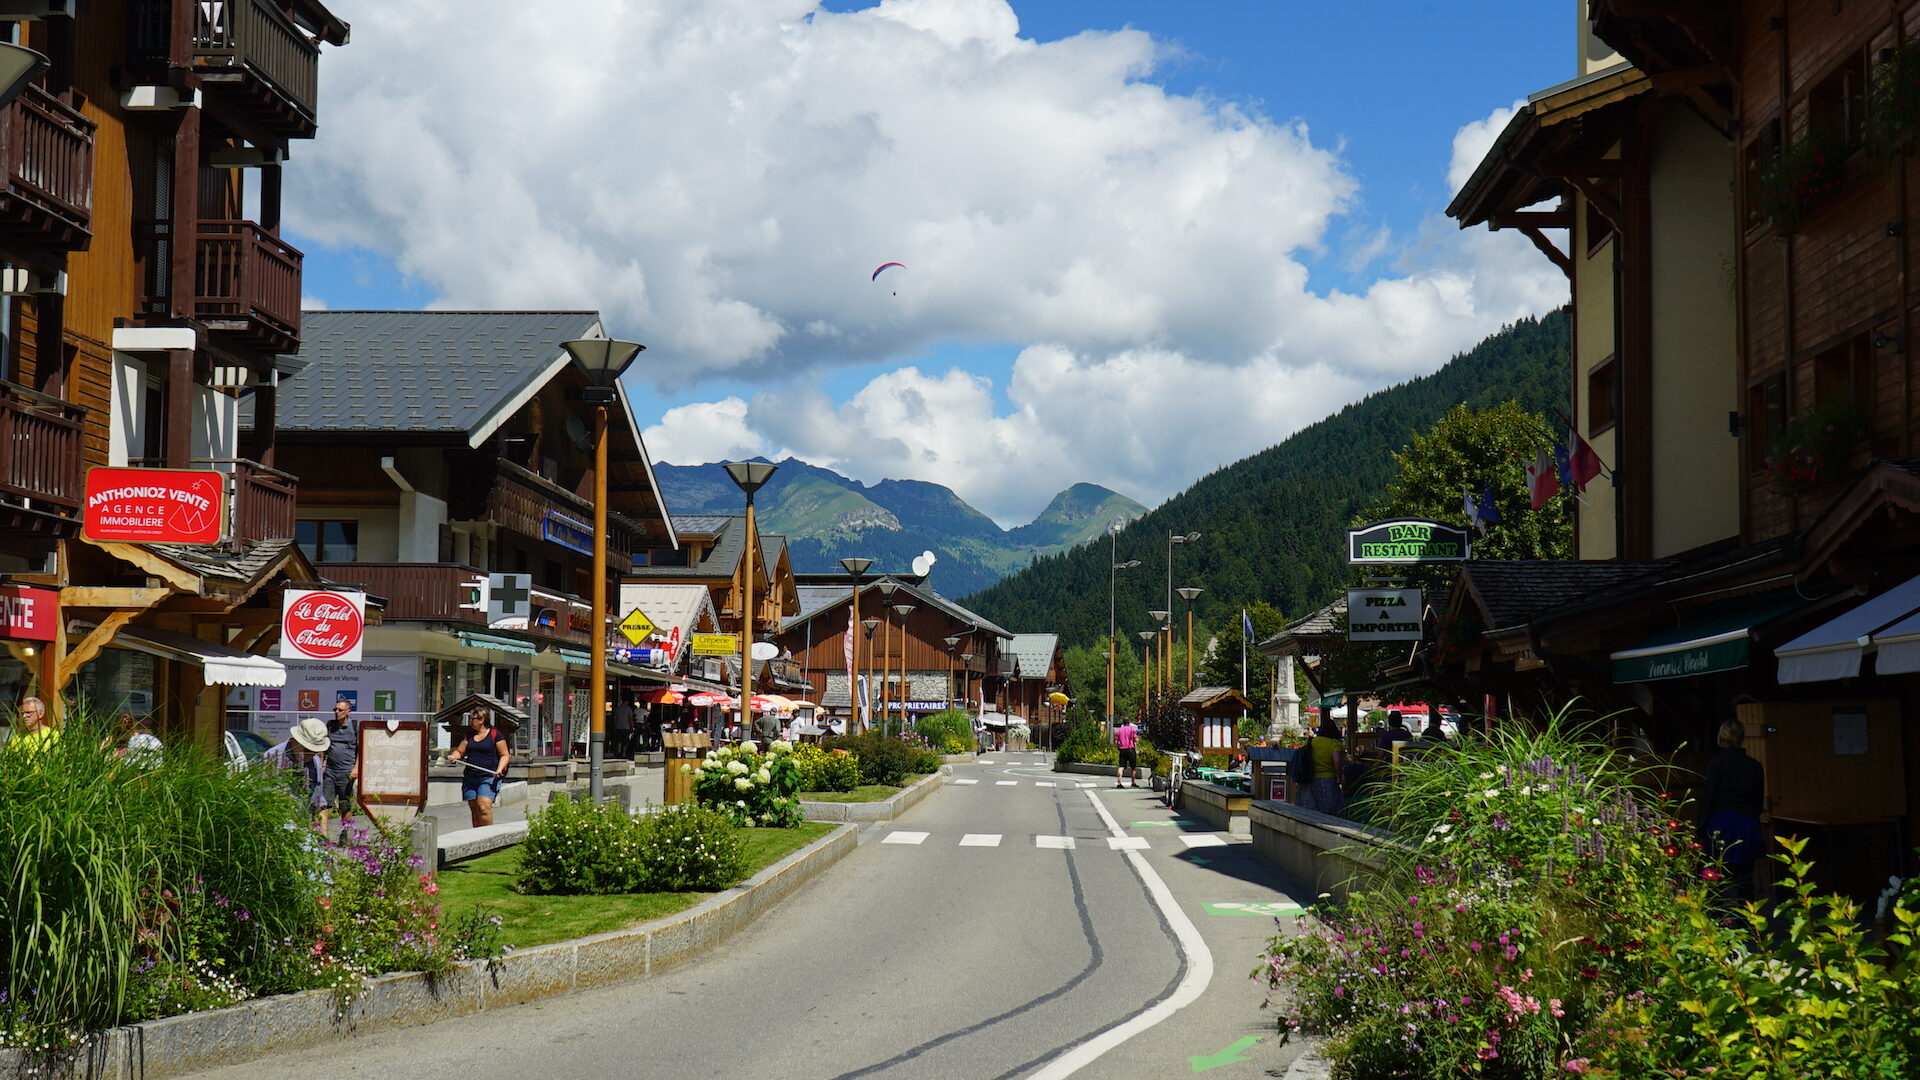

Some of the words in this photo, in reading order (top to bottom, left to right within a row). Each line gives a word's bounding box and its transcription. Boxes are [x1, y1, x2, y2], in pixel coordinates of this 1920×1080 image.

[89, 487, 166, 508] ANTHONIOZ
[169, 489, 210, 511] VENTE
[101, 504, 165, 515] AGENCE
[100, 516, 164, 527] IMMOBILIERE
[1388, 525, 1431, 541] BAR
[1362, 543, 1457, 557] RESTAURANT
[1365, 597, 1407, 607] PIZZA
[0, 595, 34, 629] NTE
[294, 602, 320, 620] Le
[314, 603, 354, 621] Chalet
[1379, 610, 1390, 619] A
[315, 619, 332, 632] du
[1351, 622, 1420, 632] EMPORTER
[296, 629, 348, 648] Chocolat
[698, 635, 730, 646] Crêperie
[288, 663, 307, 671] tériel
[346, 663, 388, 673] Orthopédie
[305, 674, 333, 682] Location
